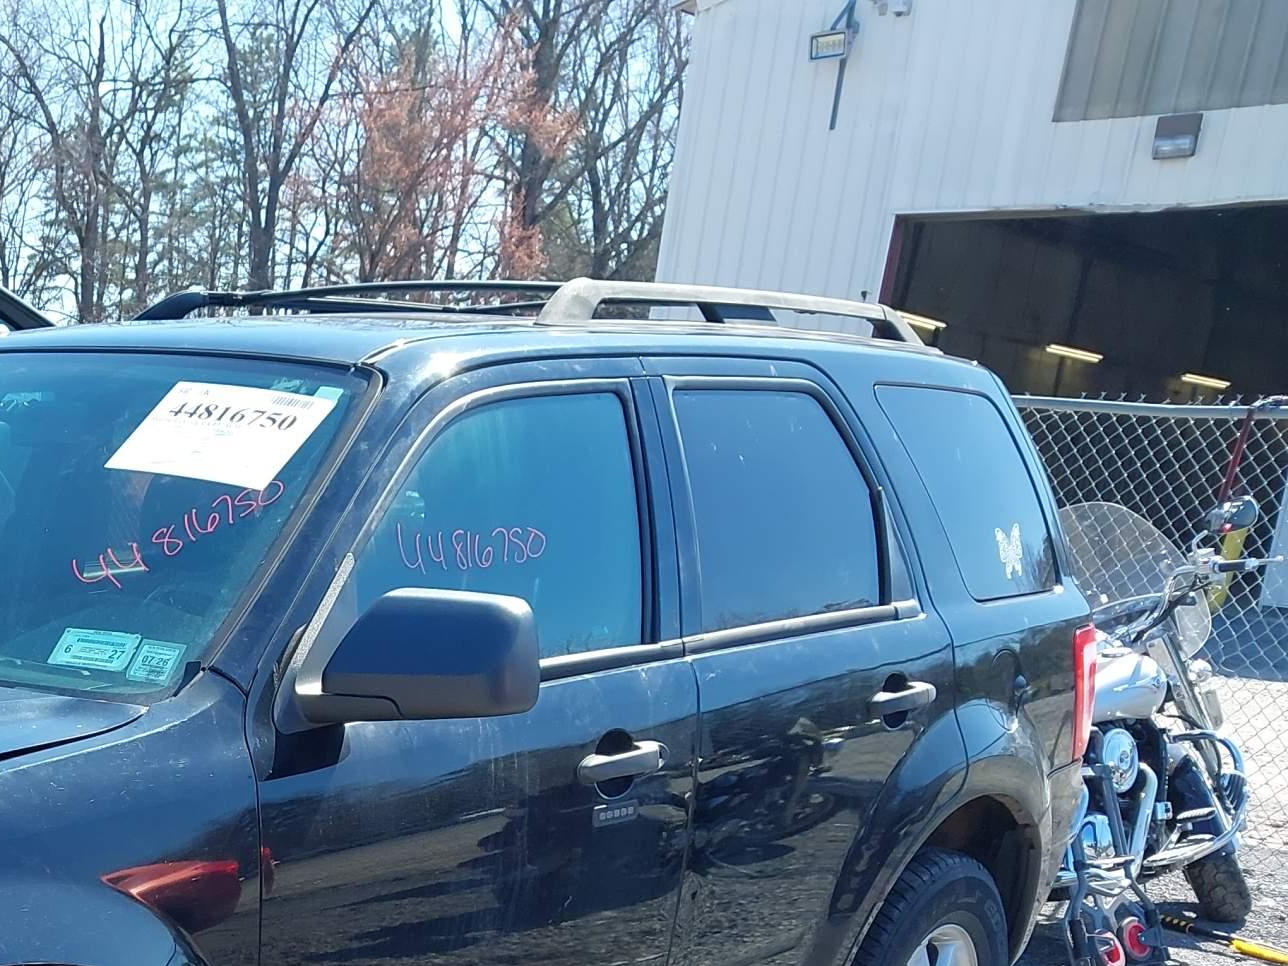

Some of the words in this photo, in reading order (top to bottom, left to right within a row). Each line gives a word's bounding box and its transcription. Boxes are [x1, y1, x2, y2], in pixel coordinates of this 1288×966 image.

[169, 402, 297, 431] 44816750
[397, 522, 546, 575] 44816750
[64, 644, 74, 653] 6
[108, 650, 126, 660] 27
